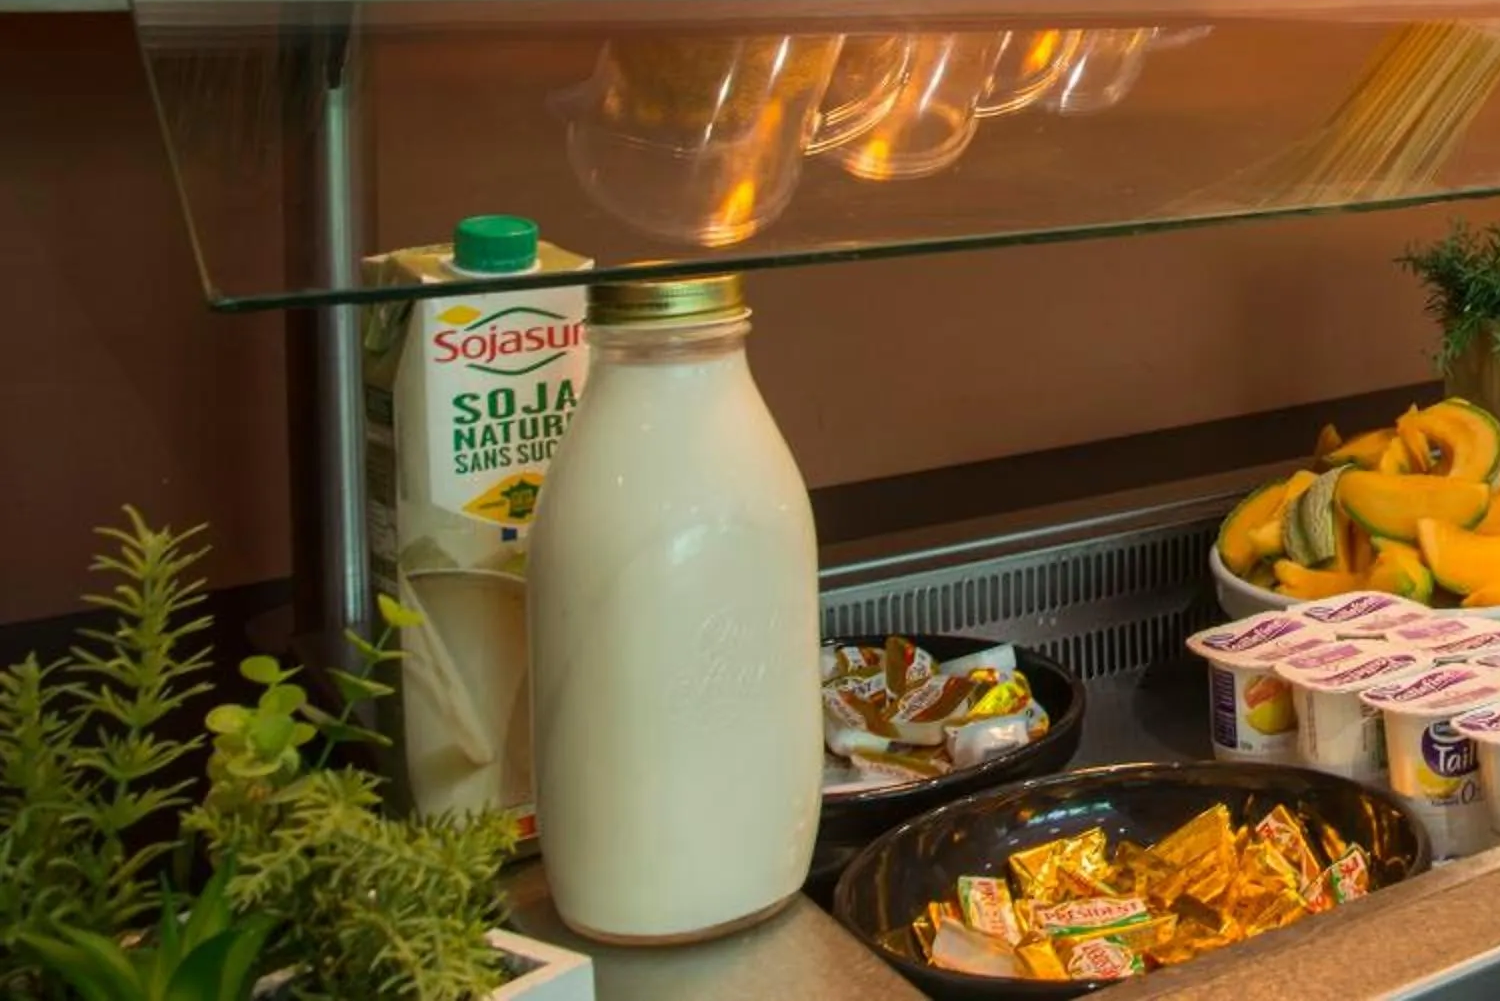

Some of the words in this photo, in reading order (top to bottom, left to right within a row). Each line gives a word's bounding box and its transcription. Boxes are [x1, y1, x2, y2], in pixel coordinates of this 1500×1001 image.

[452, 379, 577, 425] SOJA
[453, 412, 573, 452] NATUR
[454, 446, 512, 474] SANS
[517, 439, 558, 465] SUC
[1432, 741, 1474, 773] Tail
